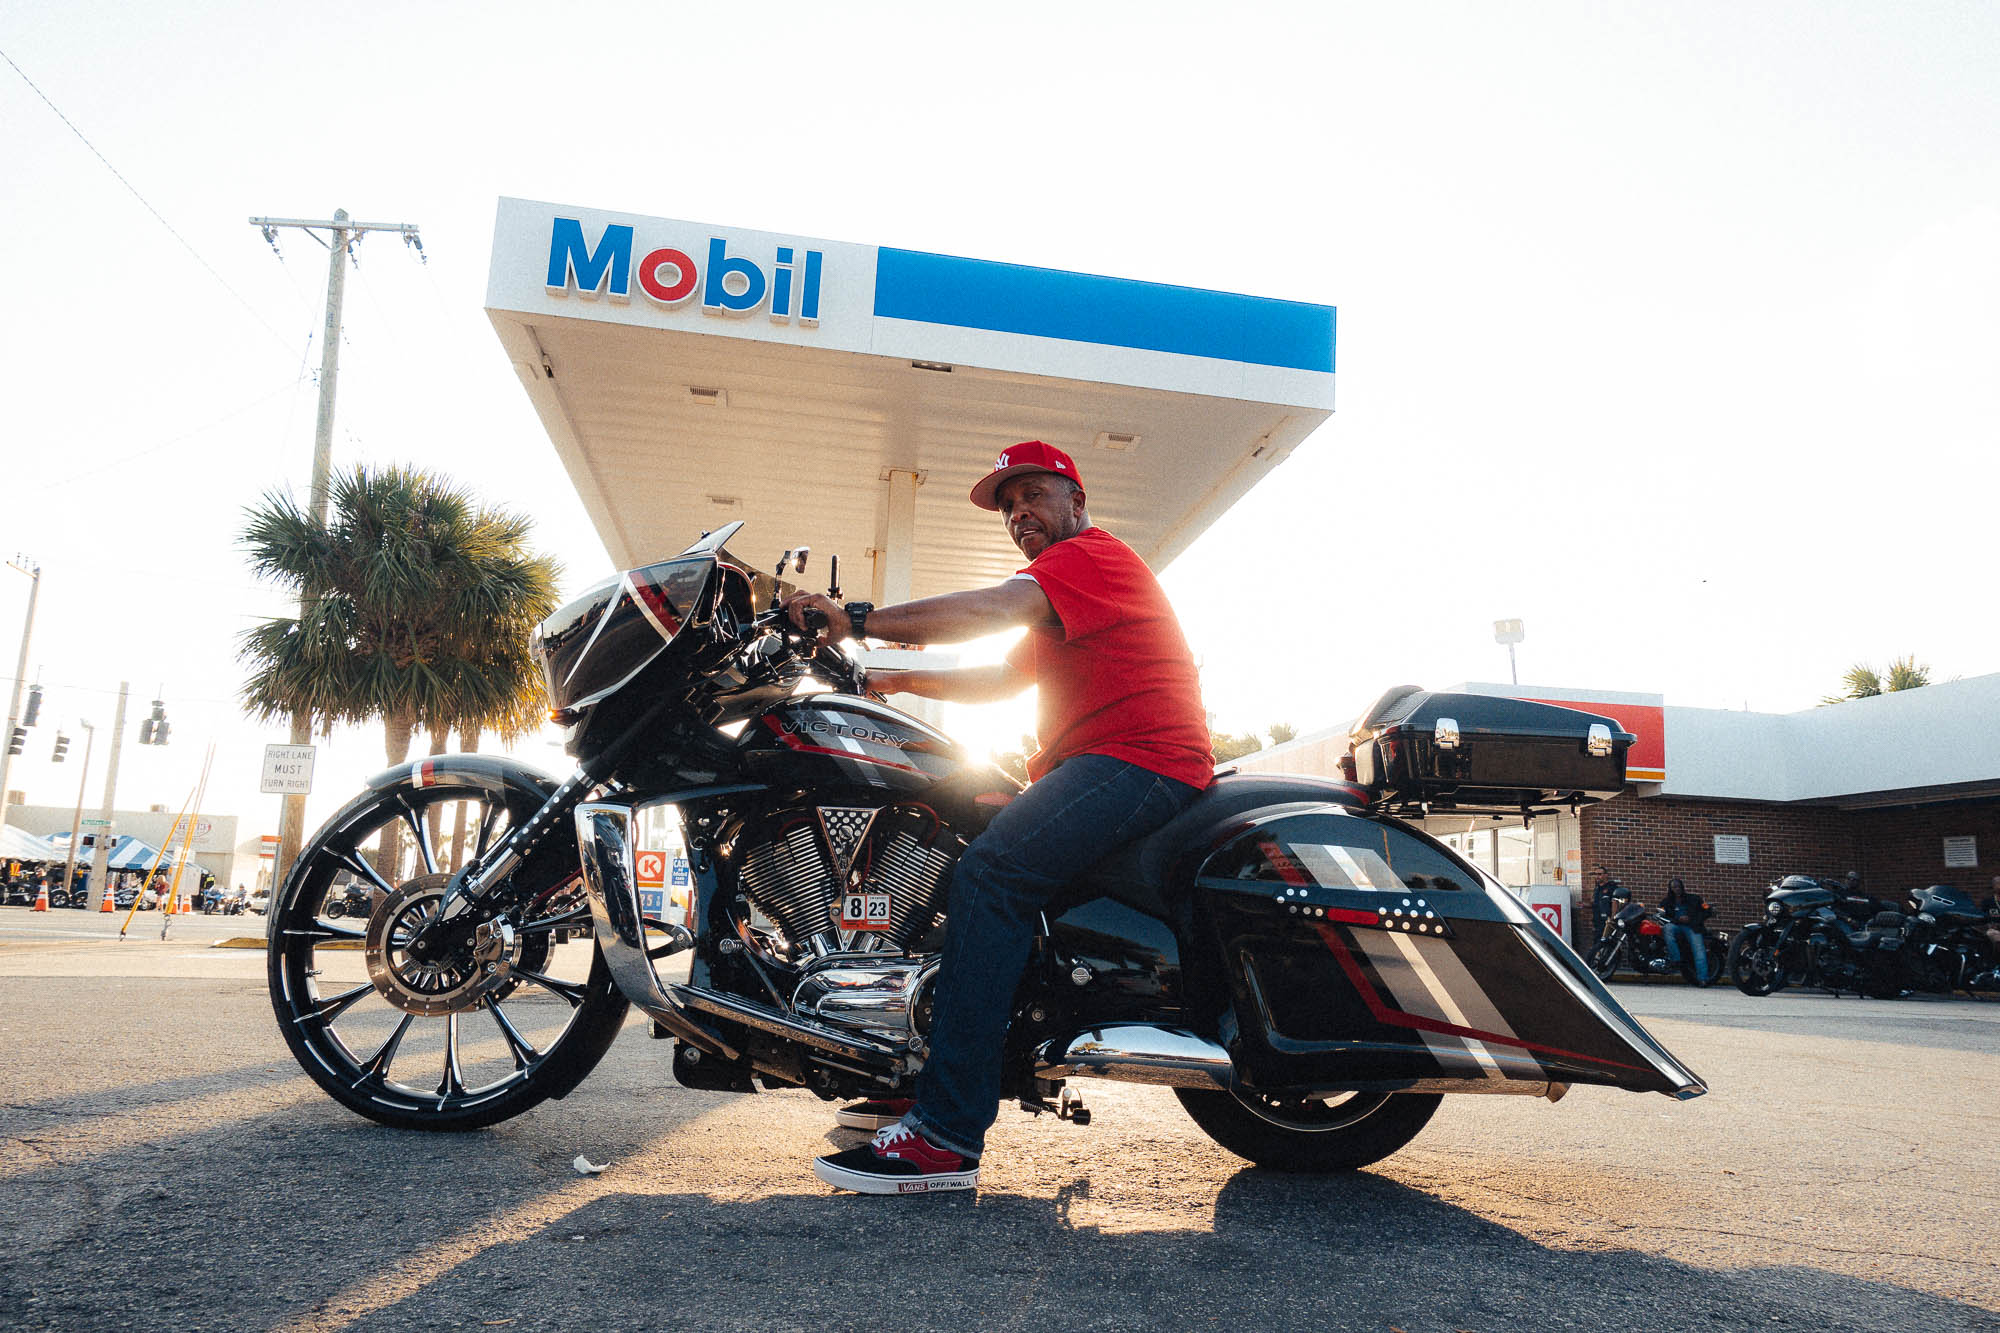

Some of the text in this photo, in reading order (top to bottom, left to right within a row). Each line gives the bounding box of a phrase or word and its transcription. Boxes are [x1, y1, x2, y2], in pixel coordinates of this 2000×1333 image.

[546, 216, 824, 323] Mobil
[780, 720, 909, 748] VICTORY
[267, 750, 313, 760] RIGHT LANE
[274, 764, 302, 775] MUST
[264, 778, 309, 789] TURN RIGHT
[643, 859, 658, 878] K
[673, 859, 689, 868] CASH
[850, 897, 862, 918] 8
[868, 901, 886, 917] 23
[903, 1180, 927, 1192] VANS
